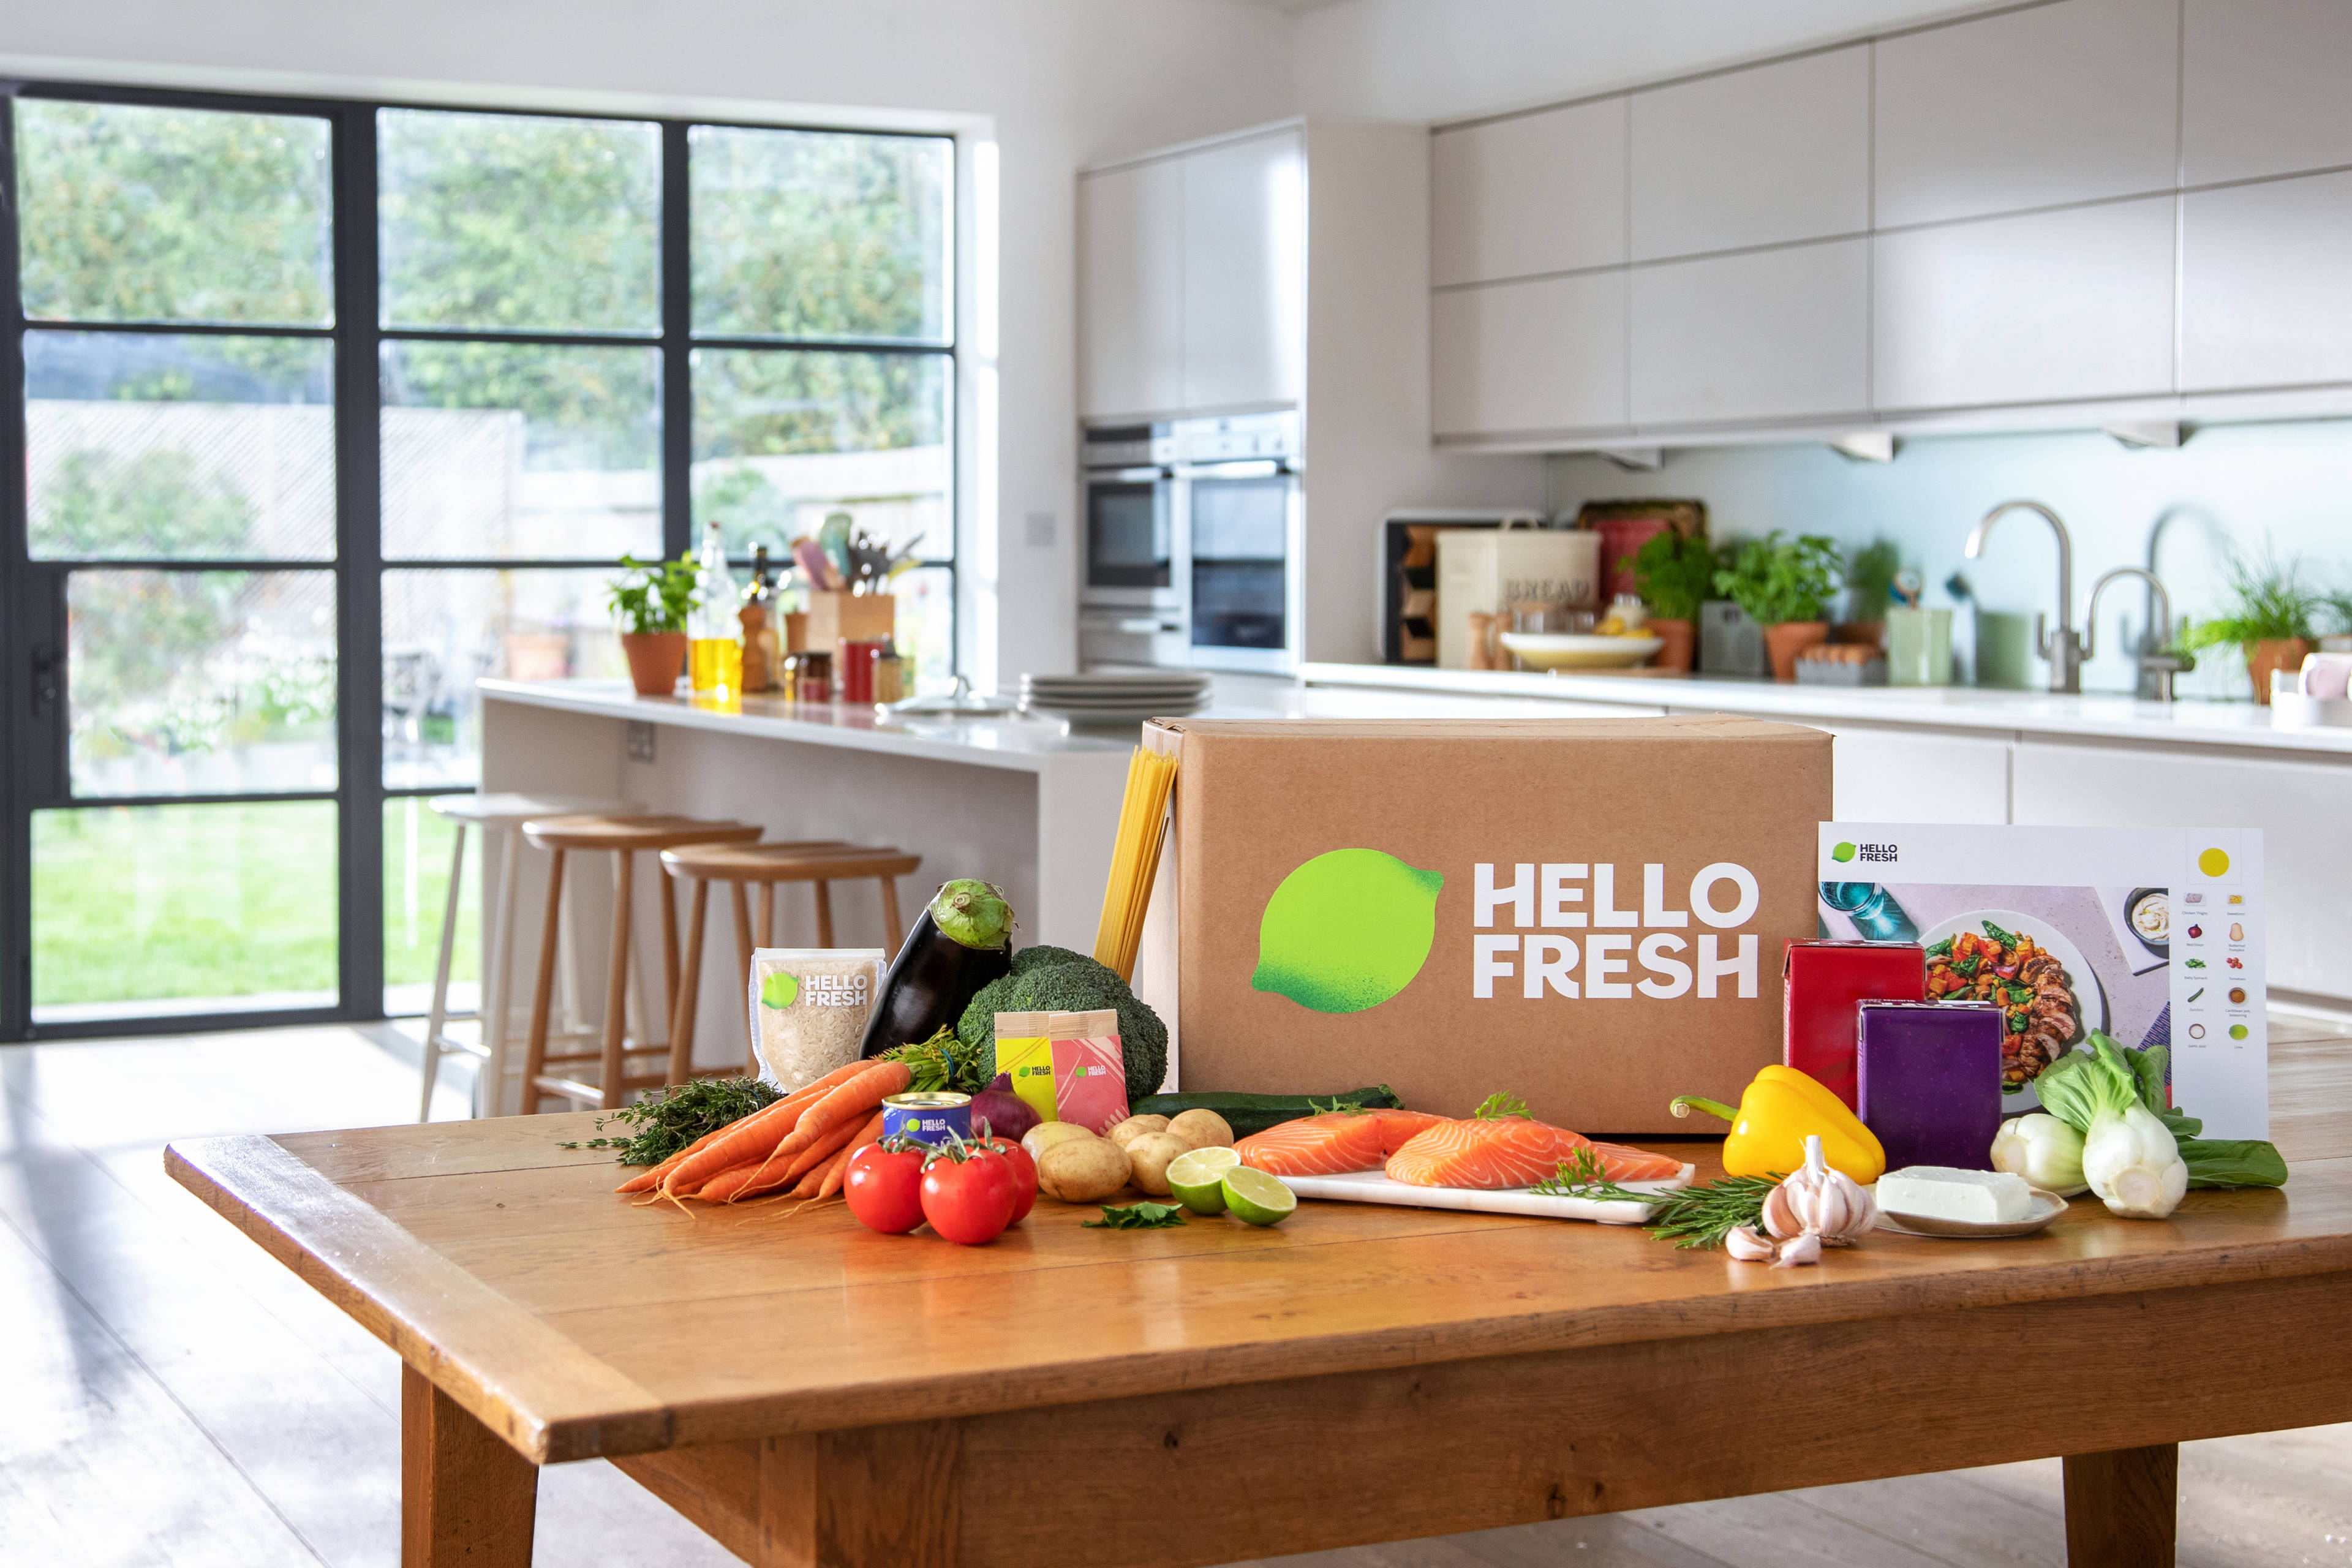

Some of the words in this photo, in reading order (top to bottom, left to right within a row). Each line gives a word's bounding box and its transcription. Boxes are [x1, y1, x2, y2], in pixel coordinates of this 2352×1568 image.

[1504, 578, 1590, 600] BREAD
[1860, 843, 1898, 853] HELLO
[1860, 853, 1898, 862] FRESH
[1474, 862, 1759, 928] HELLO
[1474, 933, 1758, 999] FRESH
[805, 975, 867, 990] HELLO
[805, 990, 867, 1006] FRESH
